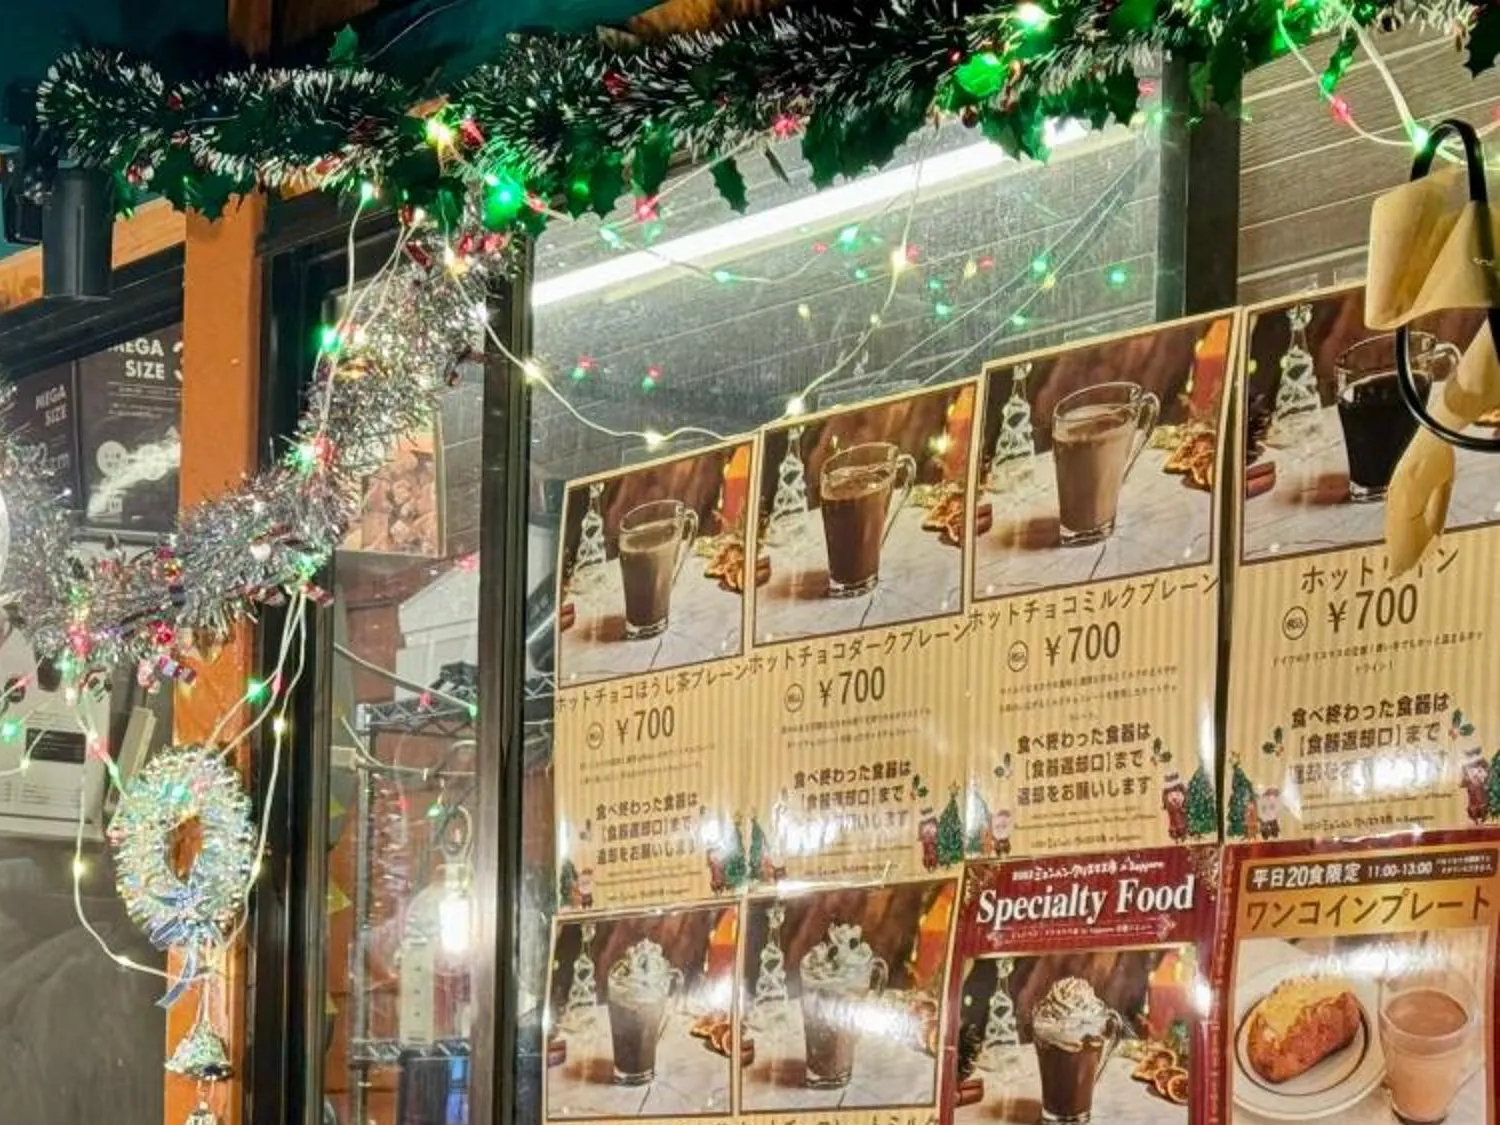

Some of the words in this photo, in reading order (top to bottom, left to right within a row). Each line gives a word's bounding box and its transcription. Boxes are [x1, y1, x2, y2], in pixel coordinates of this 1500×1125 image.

[125, 359, 165, 380] SIZE
[1301, 548, 1459, 594] ホットン
[968, 573, 1219, 631] ホットチョコミルクプレーン
[1328, 583, 1418, 633] ¥700
[748, 622, 972, 673] ホットチョコダークプレーン
[1045, 621, 1121, 667] ¥700
[556, 663, 749, 713] ホットチョコほうじ茶プレーン
[819, 666, 885, 707] ¥700
[616, 705, 675, 744] ¥700
[1291, 693, 1450, 729] 食べ終わった食器は
[1017, 722, 1151, 754] 食べ終わった食器は
[794, 760, 912, 789] 食べ終わった食器は
[1017, 776, 1151, 805] 返却をお願いします
[596, 792, 698, 820] 食べ終わった食器は
[1252, 861, 1361, 888] 平日20食限定
[976, 883, 1108, 930] Specialty
[1115, 874, 1196, 914] Food
[1247, 885, 1491, 931] ワンコインプレート
